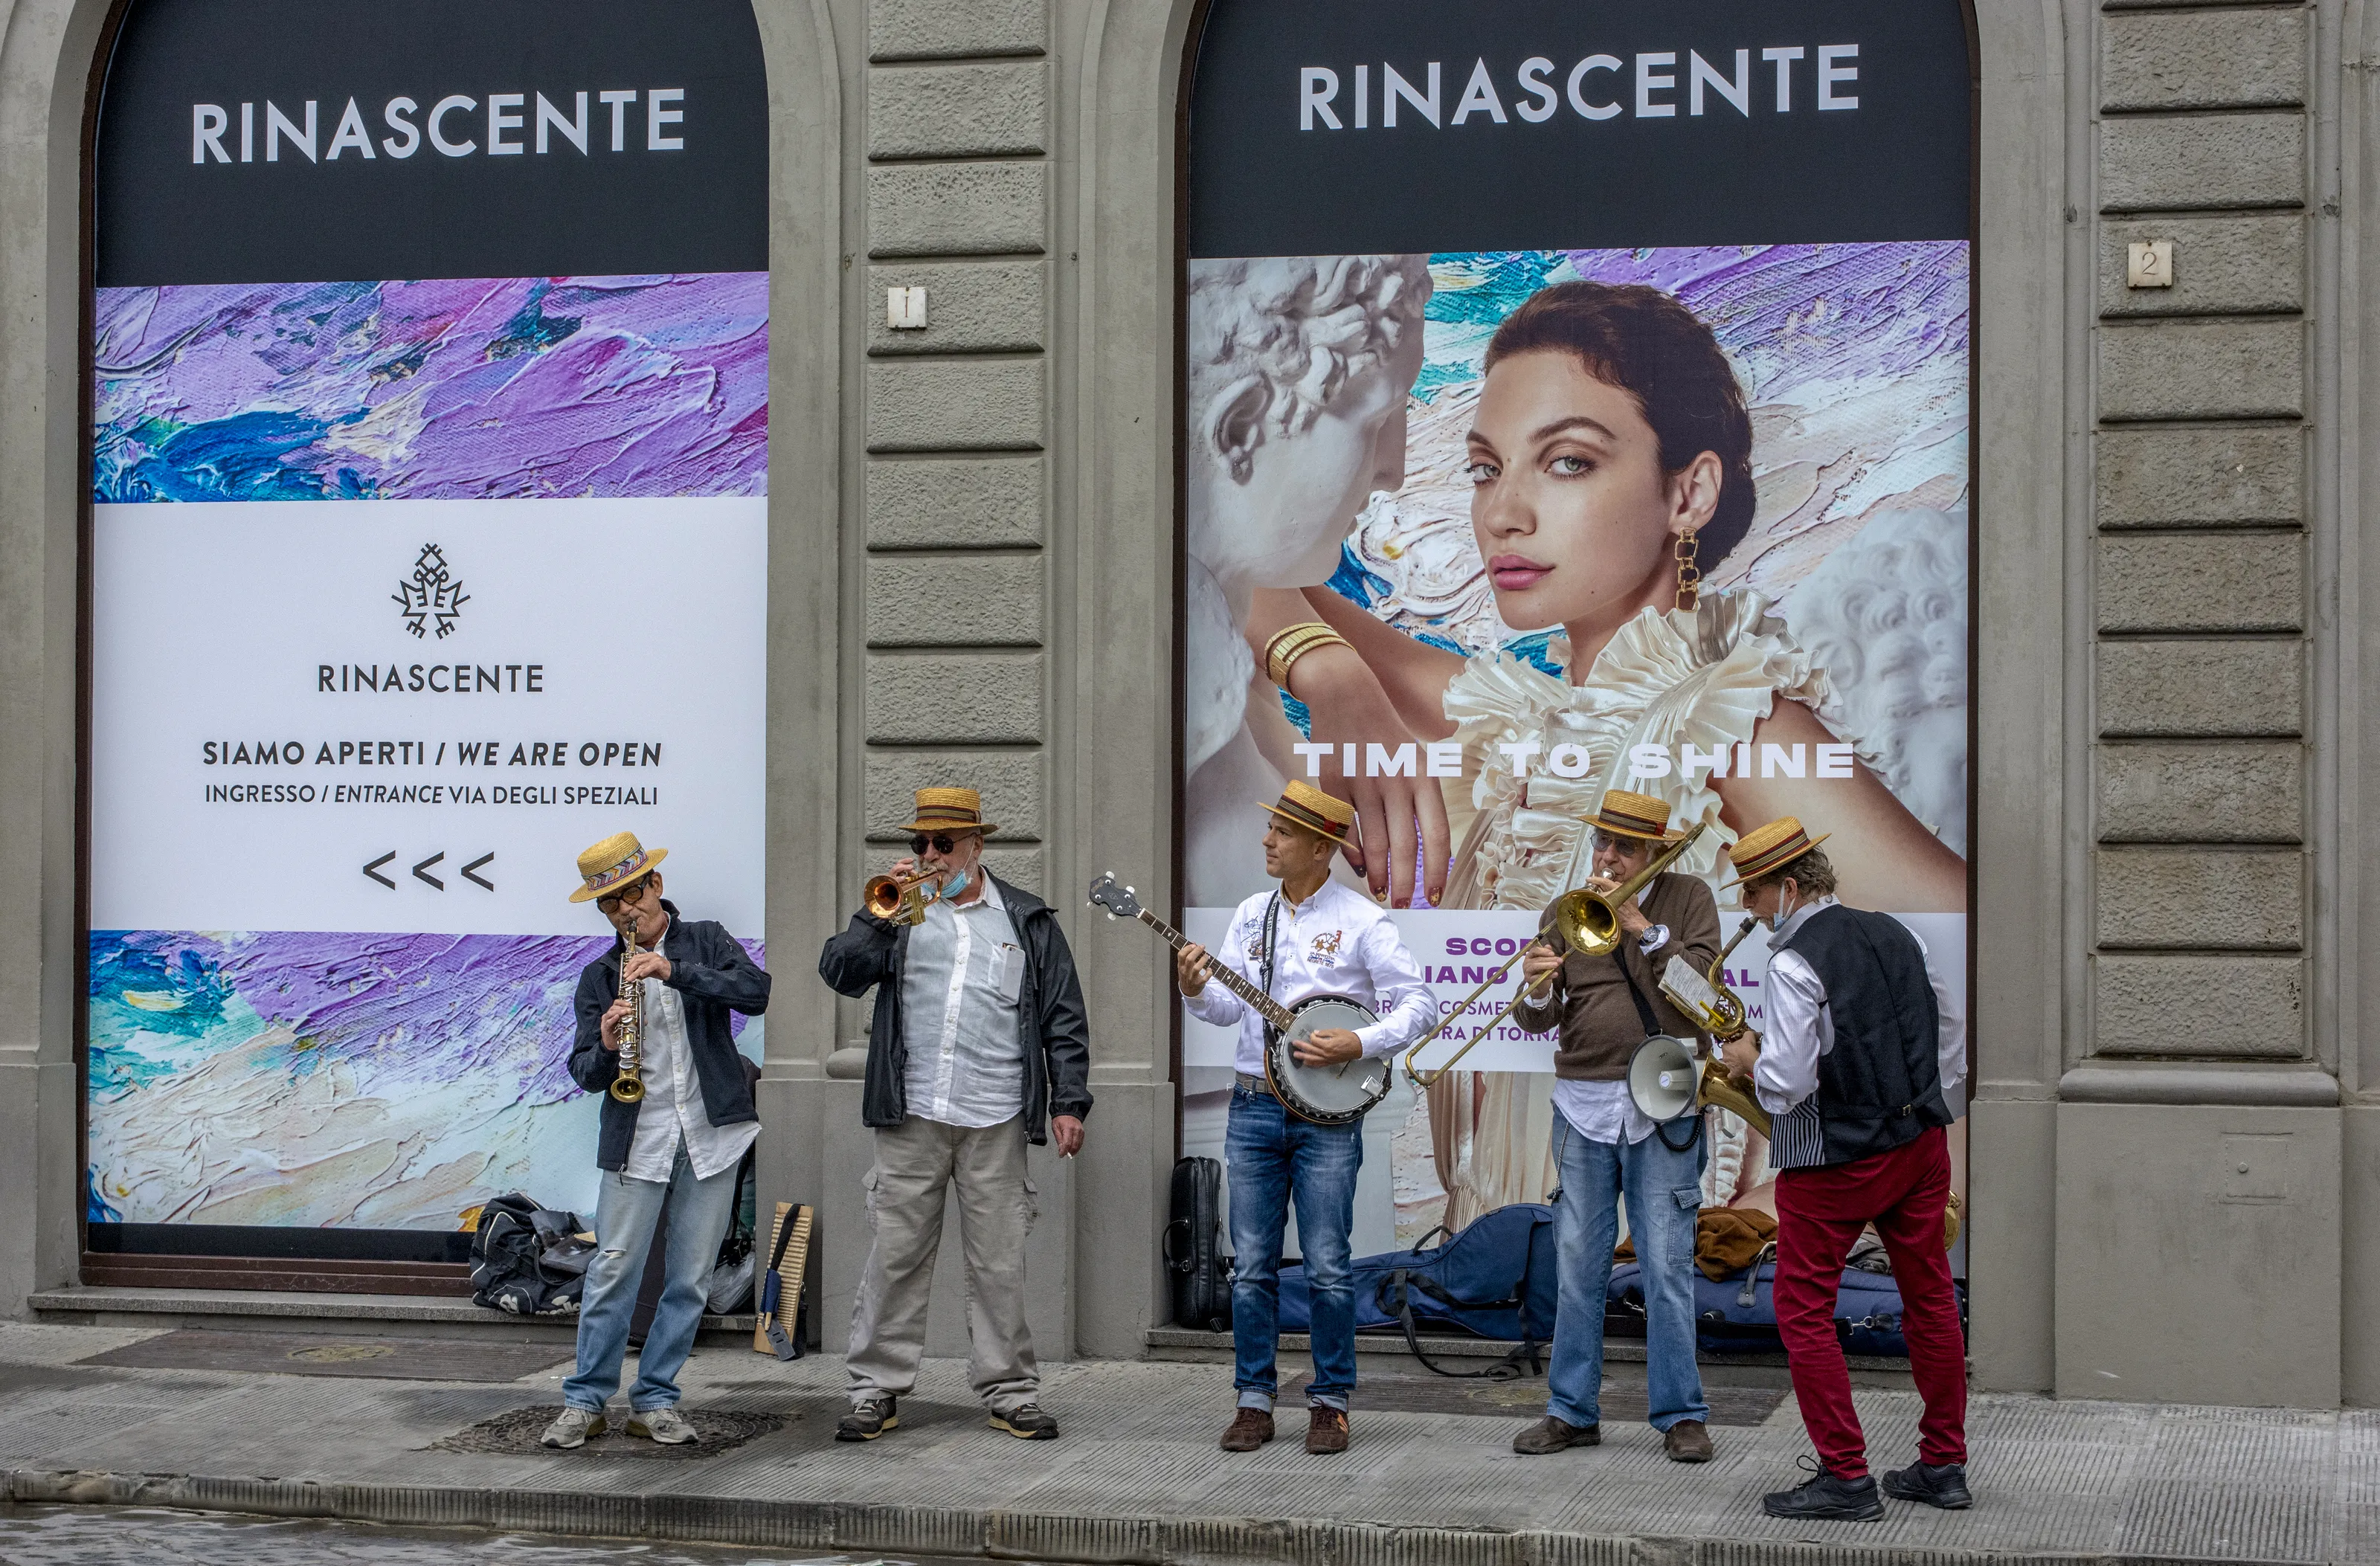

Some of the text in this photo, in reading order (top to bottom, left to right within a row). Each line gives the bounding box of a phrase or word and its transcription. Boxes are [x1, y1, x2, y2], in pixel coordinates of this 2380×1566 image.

[1300, 43, 1859, 131] RINASCENTE
[193, 88, 684, 164] RINASCENTE
[2142, 252, 2158, 275] 2
[318, 663, 543, 694] RINASCENTE
[203, 741, 305, 765] SIAMO
[315, 741, 424, 765] APERTI
[457, 741, 499, 767] WE
[507, 741, 568, 767] ARE
[579, 742, 662, 767] OPEN
[1293, 742, 1854, 779] TIME TO SHINE
[206, 784, 315, 803] INGRESSO
[334, 784, 444, 804] ENTRANCE
[448, 785, 486, 804] VIA
[493, 786, 556, 805] DEGLI
[564, 786, 657, 805] SPEZIALI
[1439, 1000, 1513, 1016] COSMET
[1473, 1026, 1492, 1041] DI
[1497, 1026, 1560, 1041] TORNA
